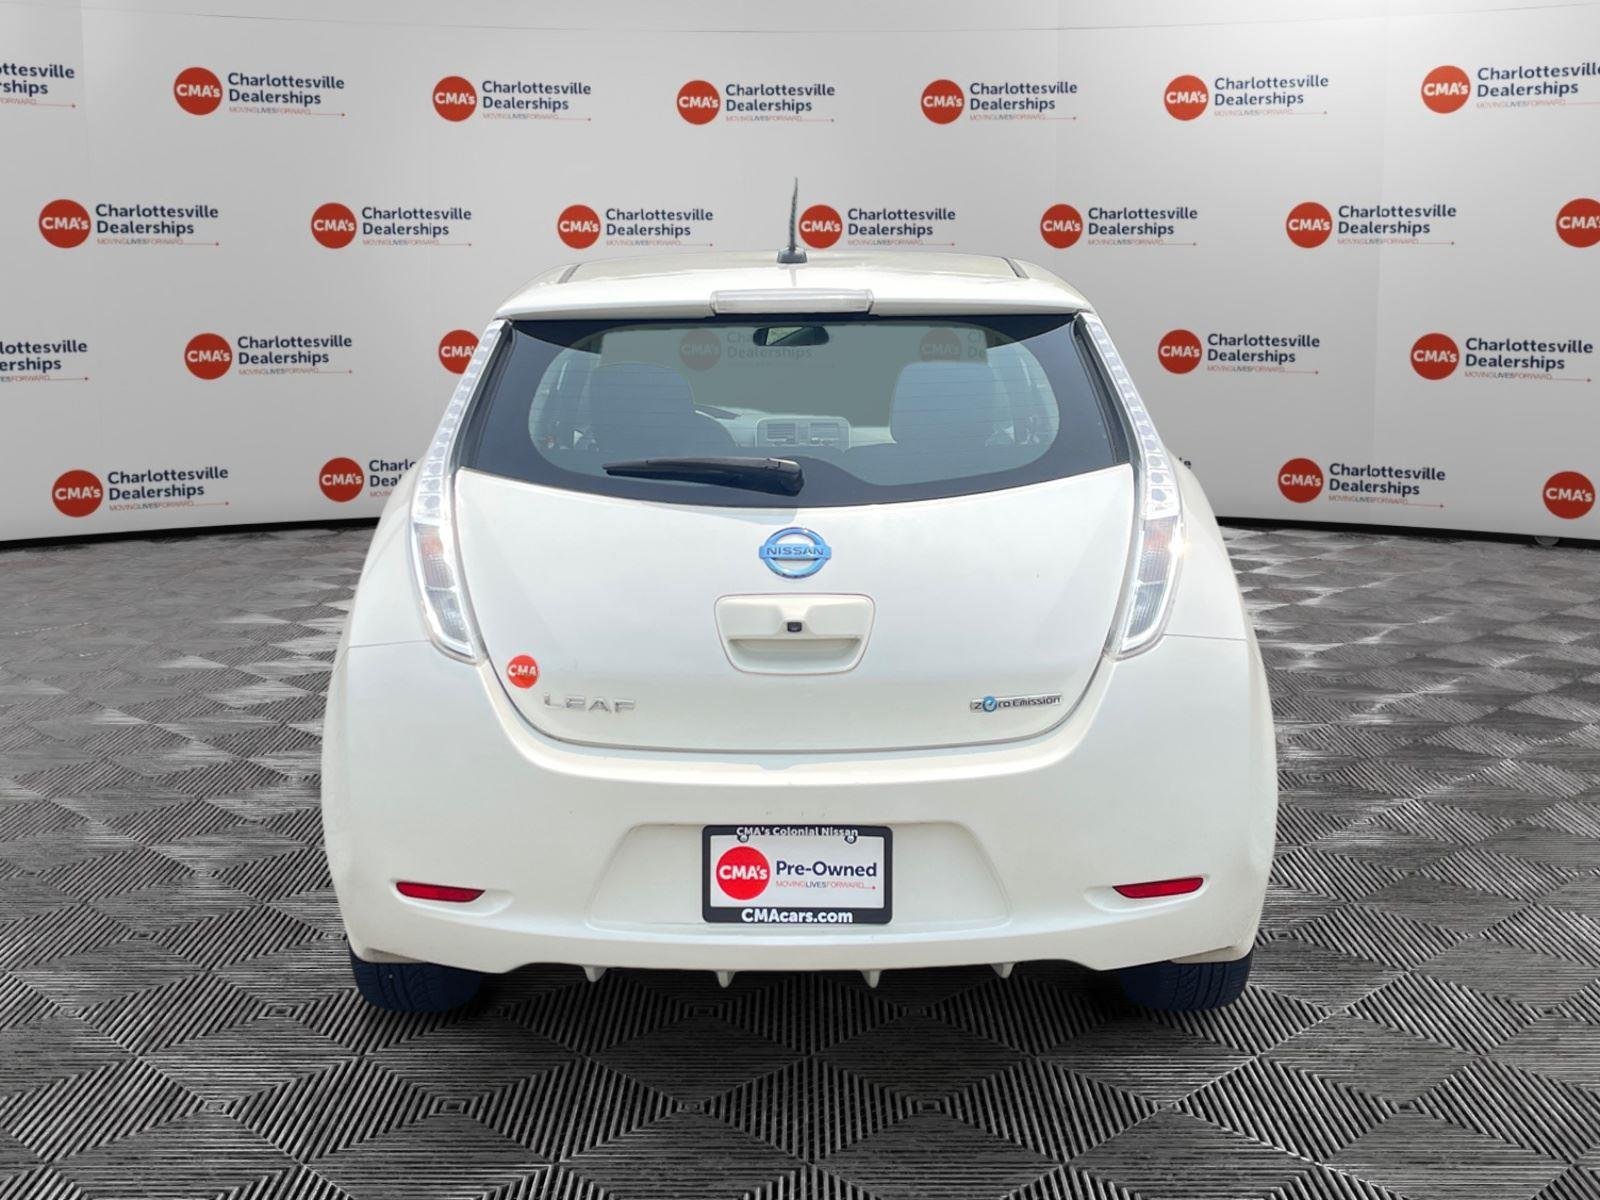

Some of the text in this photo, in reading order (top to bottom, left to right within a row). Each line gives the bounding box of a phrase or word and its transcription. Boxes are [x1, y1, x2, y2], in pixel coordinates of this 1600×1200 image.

[0, 63, 75, 78] ttesville
[228, 72, 344, 89] Charlottesville
[482, 80, 591, 95] Charlottesville
[1215, 75, 1328, 90] Charlottesville
[0, 80, 48, 97] ships
[177, 84, 220, 98] CMA's
[726, 84, 835, 96] Charlottesville
[969, 81, 1077, 95] Charlottesville
[1424, 82, 1468, 97] CMA's
[1477, 81, 1578, 97] Dealerships
[229, 89, 321, 107] Dealerships
[435, 92, 474, 105] CMA's
[679, 96, 718, 108] CMA's
[924, 95, 962, 108] CMA's
[1166, 90, 1206, 104] CMA's
[1215, 92, 1303, 107] Dealerships
[483, 96, 569, 113] Dealerships
[726, 99, 812, 114] Dealerships
[970, 97, 1055, 113] Dealerships
[95, 204, 218, 218] Charlottesville
[362, 207, 471, 220] Charlottesville
[606, 208, 713, 221] Charlottesville
[848, 208, 955, 220] Charlottesville
[1088, 207, 1198, 220] Charlottesville
[1338, 204, 1456, 218] Charlottesville
[42, 217, 89, 230] CMA's
[97, 220, 194, 237] Dealerships
[314, 219, 354, 232] CMA's
[560, 220, 598, 233] CMA's
[802, 220, 839, 232] CMA's
[1043, 220, 1080, 232] CMA's
[1289, 219, 1330, 231] CMA's
[1558, 216, 1600, 229] CMA'
[363, 222, 449, 238] Dealerships
[606, 223, 691, 239] Dealerships
[848, 223, 933, 239] Dealerships
[1089, 222, 1174, 238] Dealerships
[1338, 221, 1430, 239] Dealerships
[238, 335, 352, 349] Charlottesville
[1207, 333, 1320, 347] Charlottesville
[1466, 337, 1593, 354] Charlottesville
[188, 350, 229, 362] CMA's
[239, 351, 329, 366] Dealerships
[1161, 346, 1200, 357] CMA's
[1208, 349, 1296, 365] Dealerships
[1414, 350, 1457, 363] CMA's
[1466, 354, 1565, 372] Dealerships
[107, 466, 228, 484] Charlottesville
[1329, 463, 1445, 481] Charlottesville
[321, 474, 363, 486] CMA's
[1281, 474, 1321, 486] CMA's
[55, 487, 100, 500] CMA's
[109, 484, 204, 501] Dealerships
[1329, 478, 1419, 498] Dealerships
[1546, 488, 1592, 502] CMA's
[766, 546, 824, 556] NISSAN
[543, 692, 636, 713] LEAF
[736, 827, 858, 837] CMA's Colonial Nissan
[719, 864, 769, 881] CMA's
[776, 860, 878, 877] Pre-Owned
[741, 908, 854, 924] CMAcars.com
